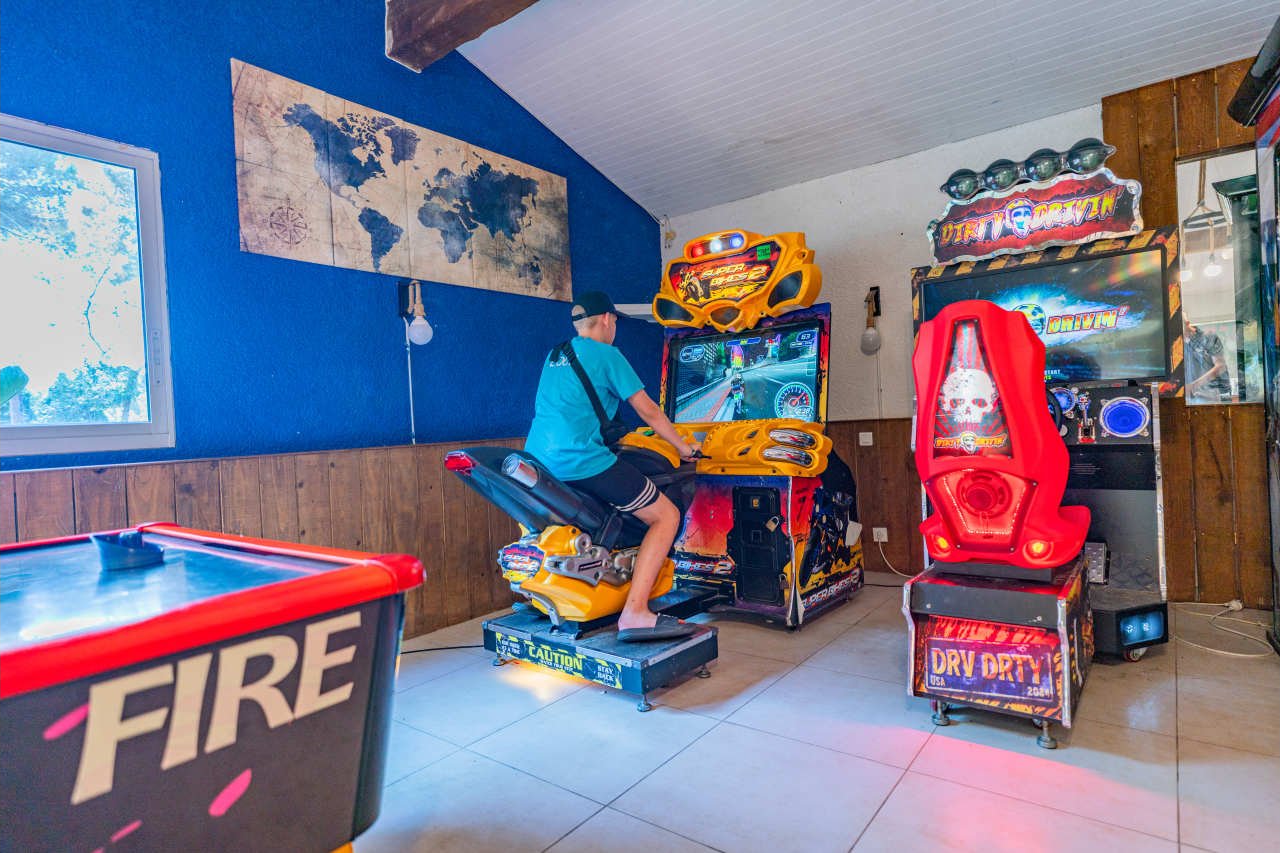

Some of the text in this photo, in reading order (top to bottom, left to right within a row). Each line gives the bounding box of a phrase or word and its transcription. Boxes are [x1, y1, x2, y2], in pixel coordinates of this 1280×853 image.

[939, 209, 1006, 247] DIRTY
[702, 263, 745, 280] SUPER
[710, 265, 769, 286] BIKES 2
[677, 560, 716, 572] BIKES
[713, 560, 734, 575] 2
[850, 567, 861, 584] 2
[528, 645, 583, 670] CAUTION
[930, 647, 1042, 684] DRV DRTY
[930, 675, 946, 686] USA
[70, 611, 361, 806] FIRE
